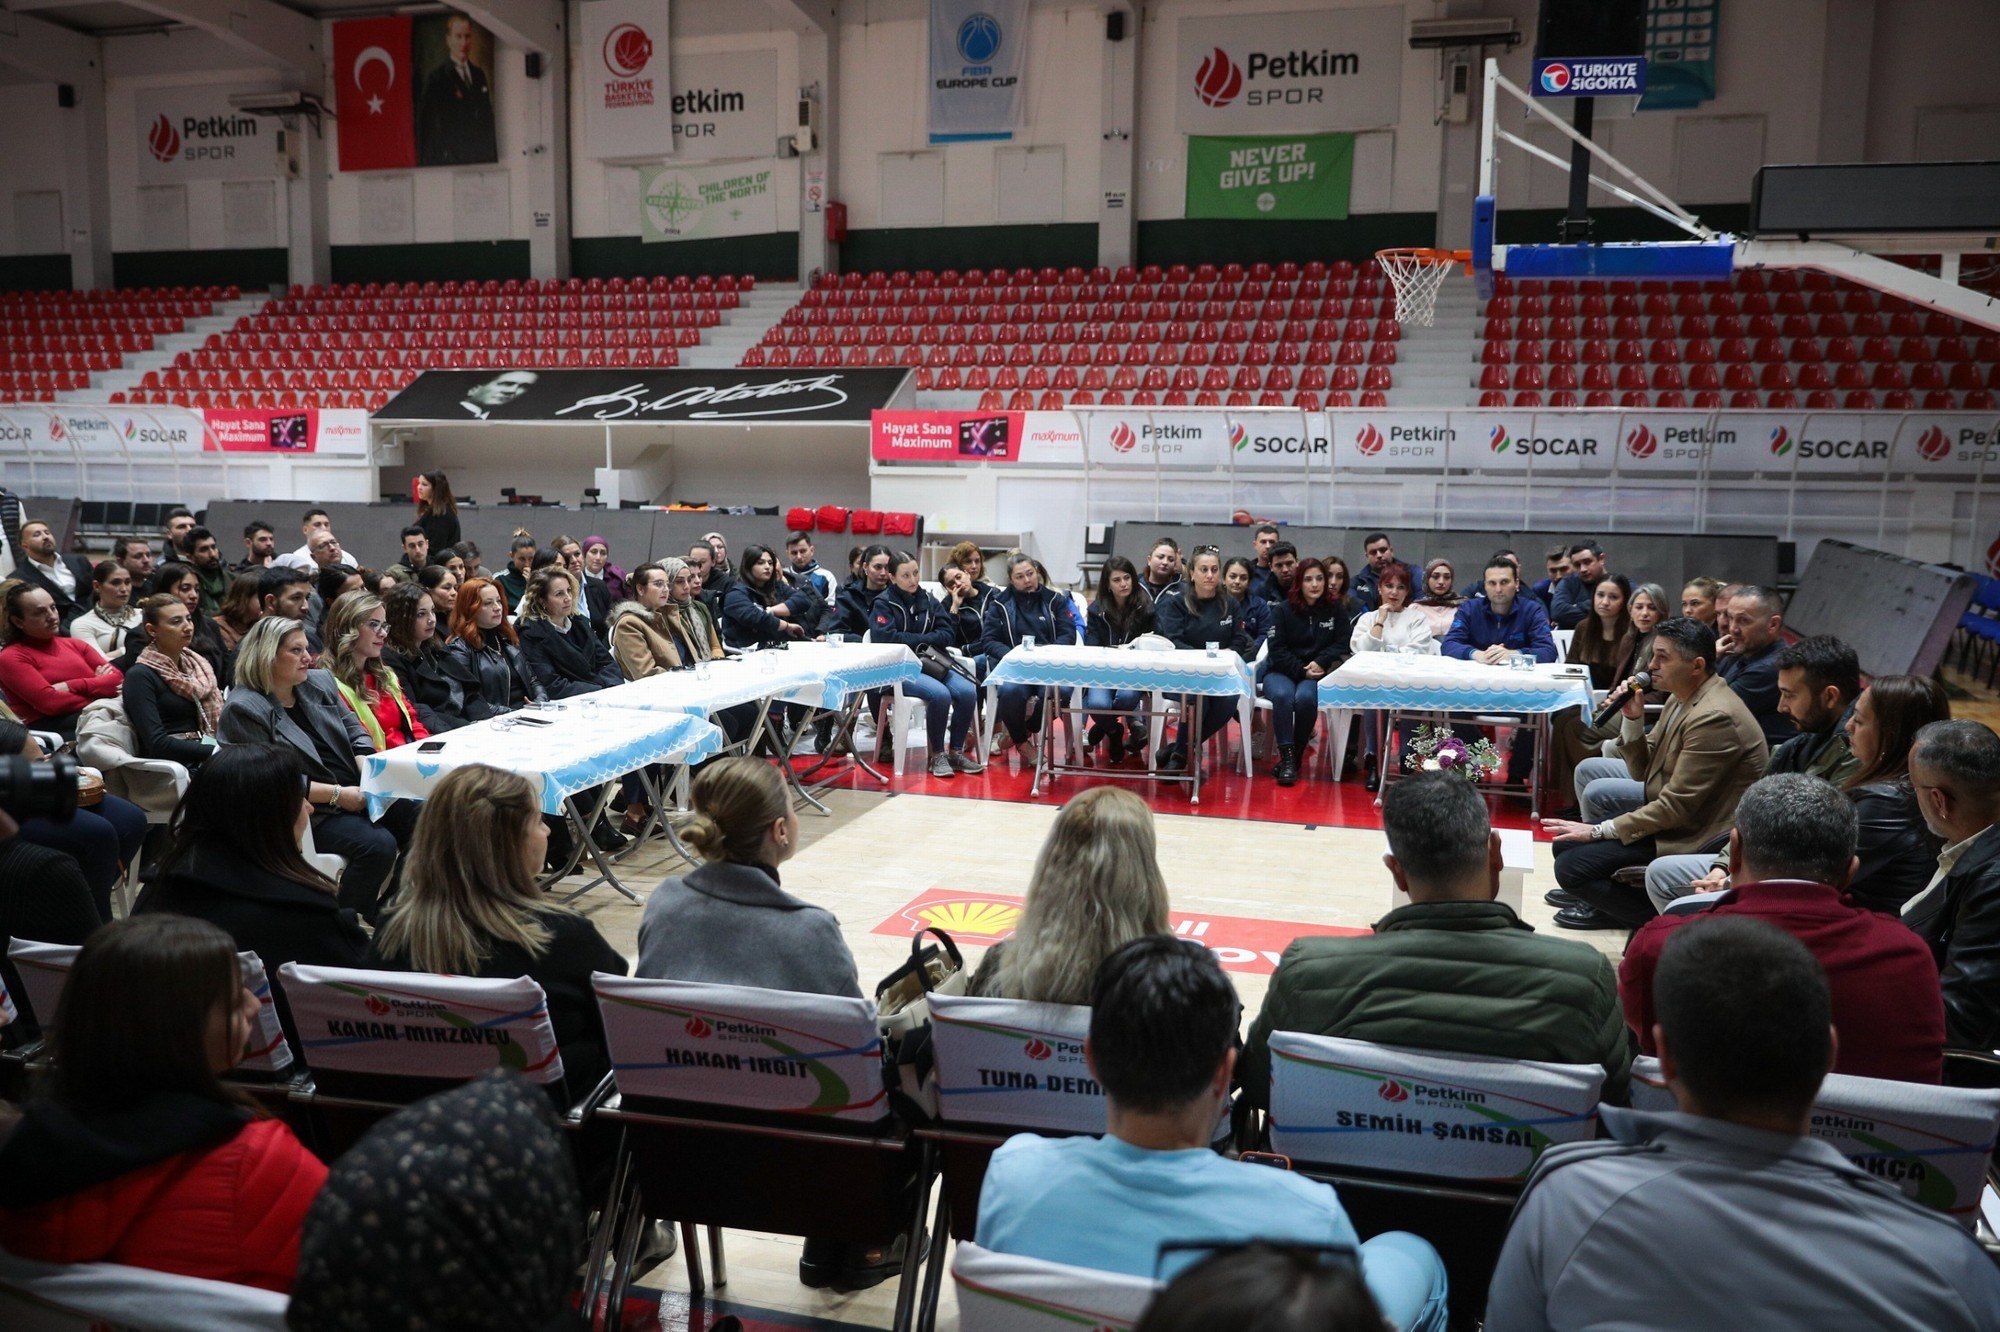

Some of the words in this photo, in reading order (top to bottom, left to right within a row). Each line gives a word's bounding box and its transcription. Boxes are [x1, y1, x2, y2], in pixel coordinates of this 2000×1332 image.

[962, 66, 992, 76] FIBA
[1248, 50, 1359, 79] Petkim
[1571, 62, 1638, 78] TÜRKİYE
[604, 78, 653, 94] TÜRKİYE
[936, 77, 988, 89] EUROPE
[992, 76, 1017, 87] CUP
[1571, 76, 1638, 91] SİGORTA
[671, 89, 744, 115] etkim
[1247, 88, 1324, 106] SPOR
[184, 115, 257, 139] Petkim
[671, 123, 715, 138] POR
[185, 145, 235, 161] SPOR
[1229, 143, 1307, 169] NEVER
[698, 174, 753, 195] CHILDREN
[756, 171, 770, 182] OF
[1219, 167, 1271, 190] GIVE
[1278, 161, 1316, 183] UP!
[704, 190, 726, 205] THE
[729, 184, 766, 200] NORTH
[69, 418, 109, 431] Petkim
[211, 419, 241, 431] Hayat
[242, 419, 266, 431] Sana
[882, 422, 919, 437] Hayat
[922, 422, 952, 434] Sana
[1142, 424, 1202, 440] Petkim
[140, 429, 188, 442] SOCAR
[219, 431, 266, 442] Maximum
[891, 436, 952, 448] Maximum
[1031, 430, 1080, 442] maximum
[1141, 444, 1183, 453] SPOR
[1253, 437, 1328, 453] SOCAR
[1389, 446, 1434, 456] SPOR
[1515, 438, 1597, 455] SOCAR
[1798, 440, 1888, 460] SOCAR
[327, 1018, 400, 1041] KANAN
[716, 1020, 777, 1037] Petkim
[717, 1033, 760, 1043] SPOR
[1057, 1041, 1086, 1054] Pet
[665, 1047, 742, 1071] HAKAN
[977, 1068, 1038, 1090] TUNA
[1046, 1074, 1107, 1096] DEM
[1414, 1084, 1487, 1104] Petkim
[1415, 1099, 1467, 1110] SPOR
[1336, 1109, 1423, 1135] SEMİH
[1432, 1120, 1538, 1148] ŞANSAL
[1811, 1115, 1875, 1132] etkim
[1809, 1127, 1849, 1139] POR
